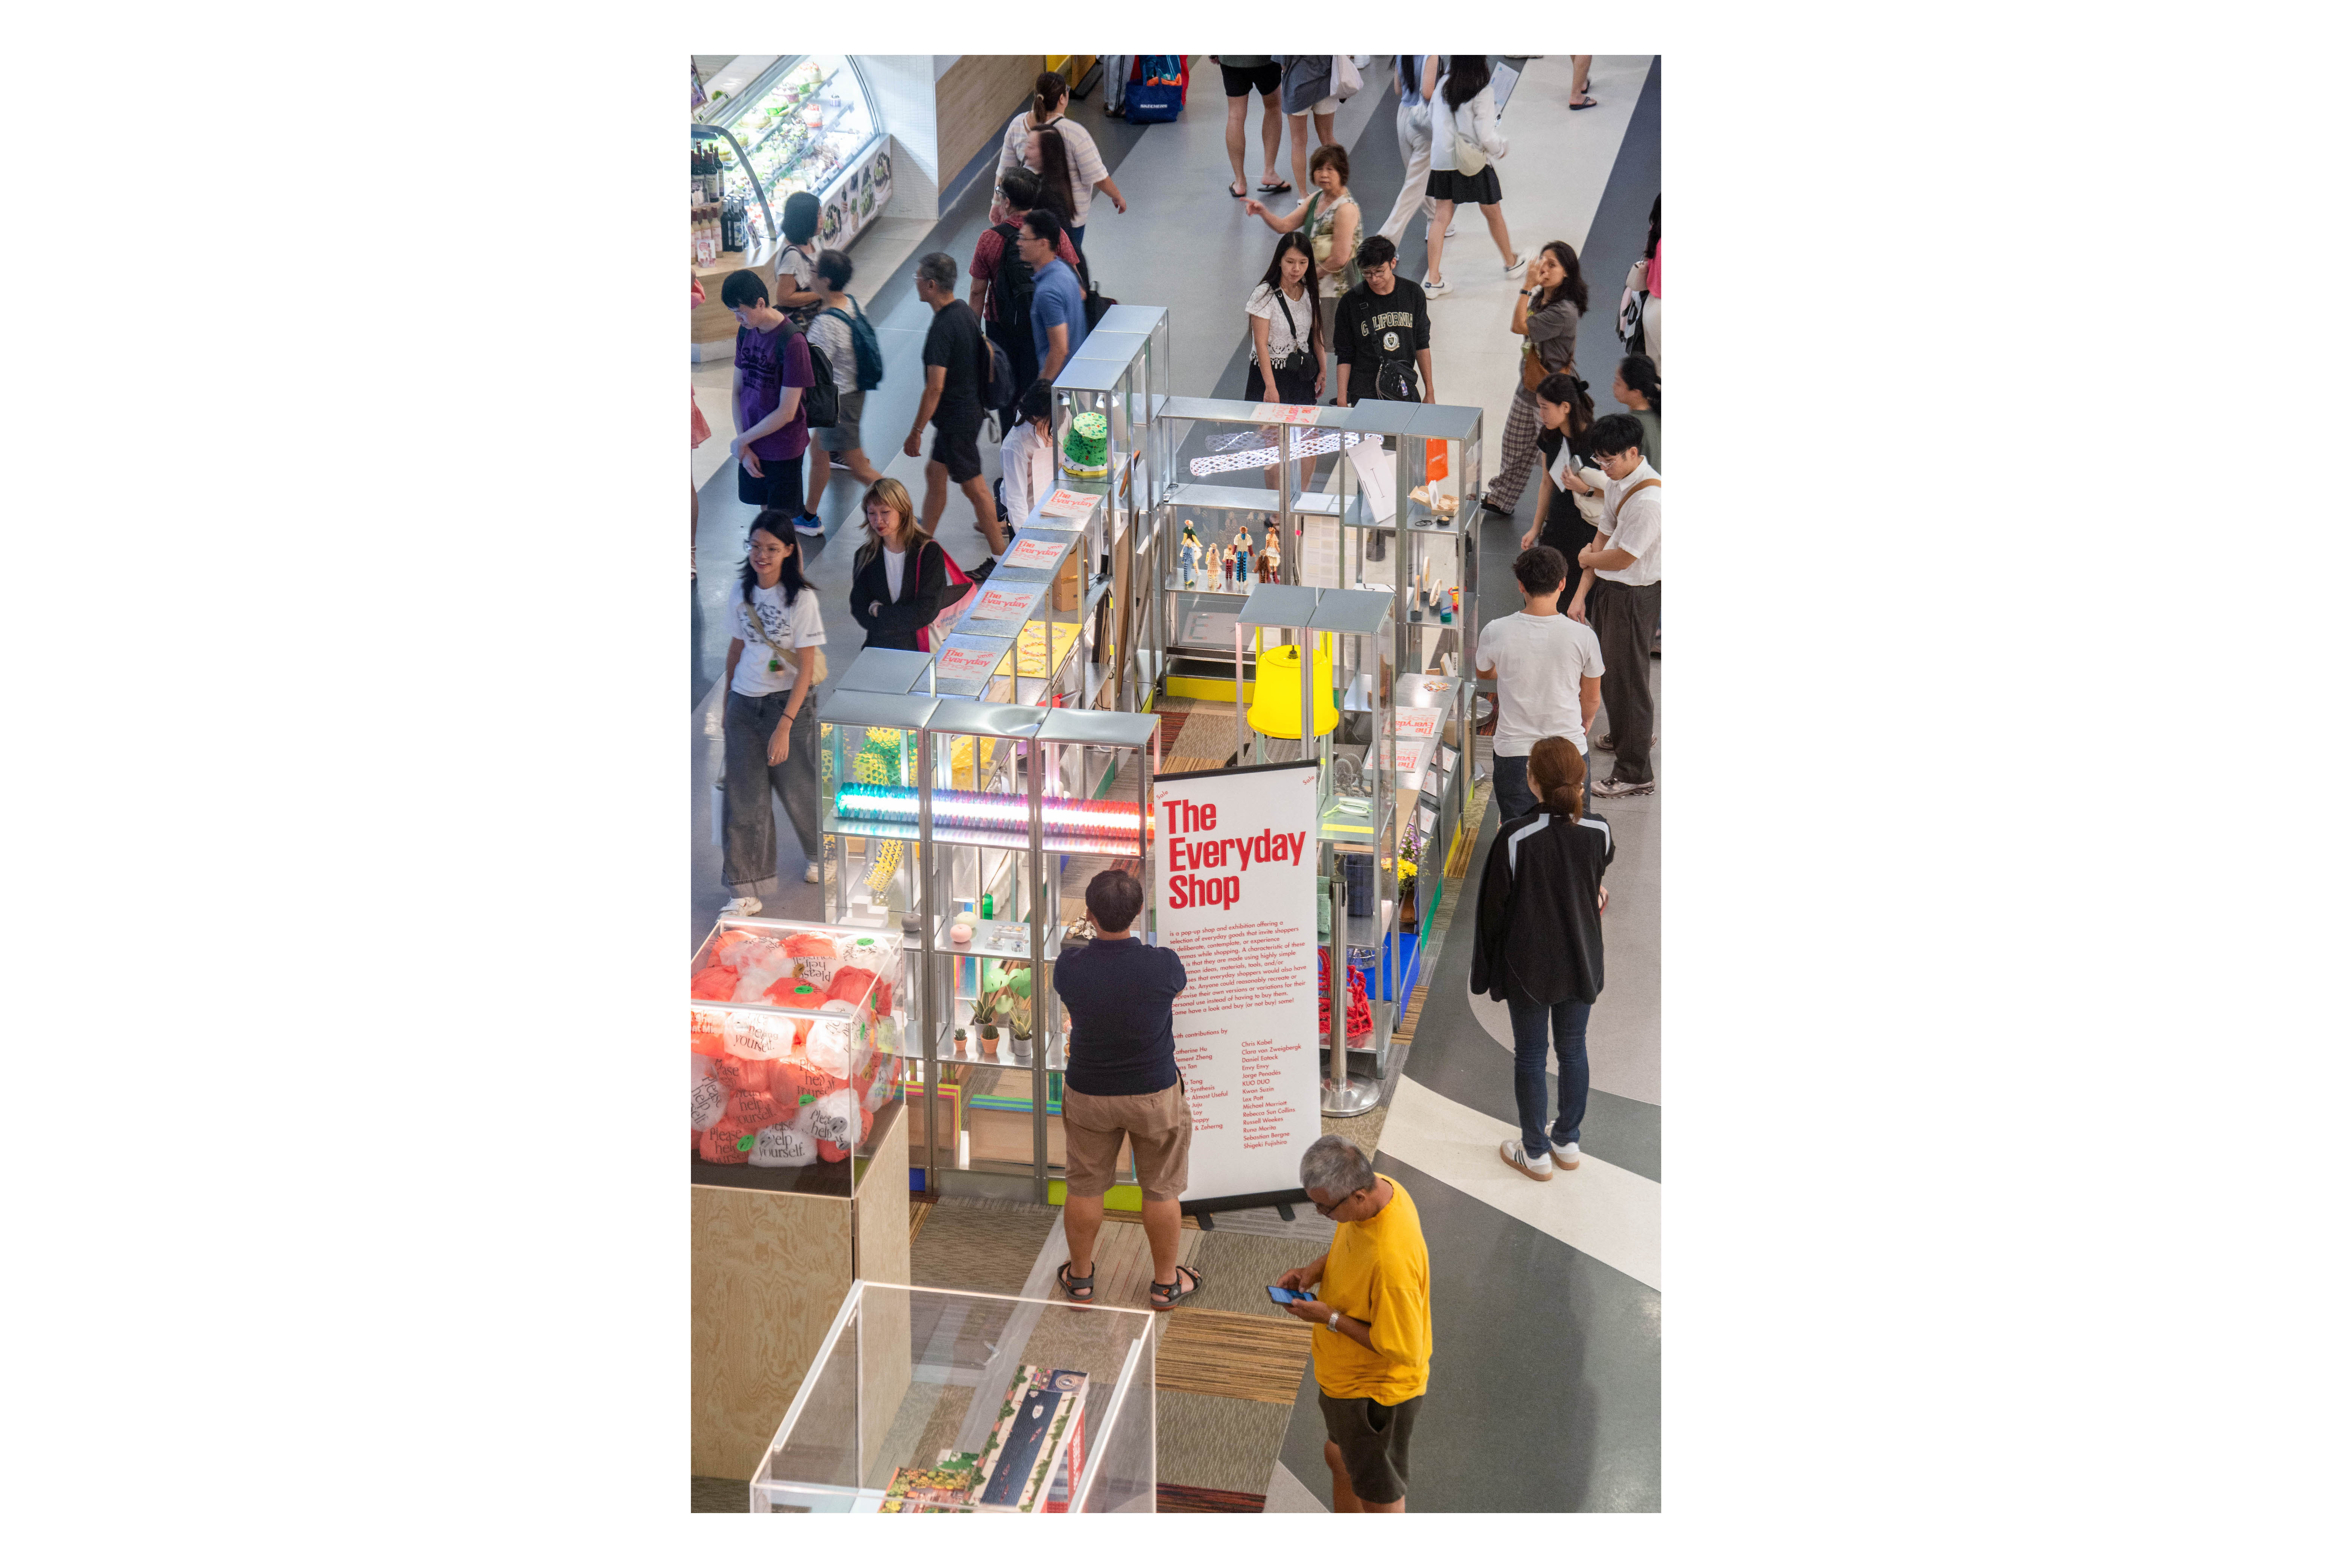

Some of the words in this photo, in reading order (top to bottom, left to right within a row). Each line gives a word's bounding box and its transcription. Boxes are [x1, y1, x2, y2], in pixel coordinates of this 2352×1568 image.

[1361, 312, 1413, 336] CLIFORNIA
[1282, 406, 1299, 423] Everyday
[1051, 496, 1094, 507] Everyday
[1015, 546, 1060, 557] Everyday
[981, 597, 1028, 608] Everyday
[942, 655, 990, 667] Everyday
[1303, 775, 1315, 785] Sale
[1156, 790, 1168, 800] Sale
[1162, 799, 1216, 835] The
[1169, 828, 1306, 872] Everyday
[1169, 874, 1240, 910] Shop
[802, 969, 831, 982] Pleas
[1270, 1044, 1301, 1052] Zweigbergk
[692, 1085, 710, 1110] help
[739, 1097, 762, 1113] help
[710, 1128, 741, 1141] Please
[715, 1141, 735, 1154] hel
[759, 1142, 805, 1160] yourself.
